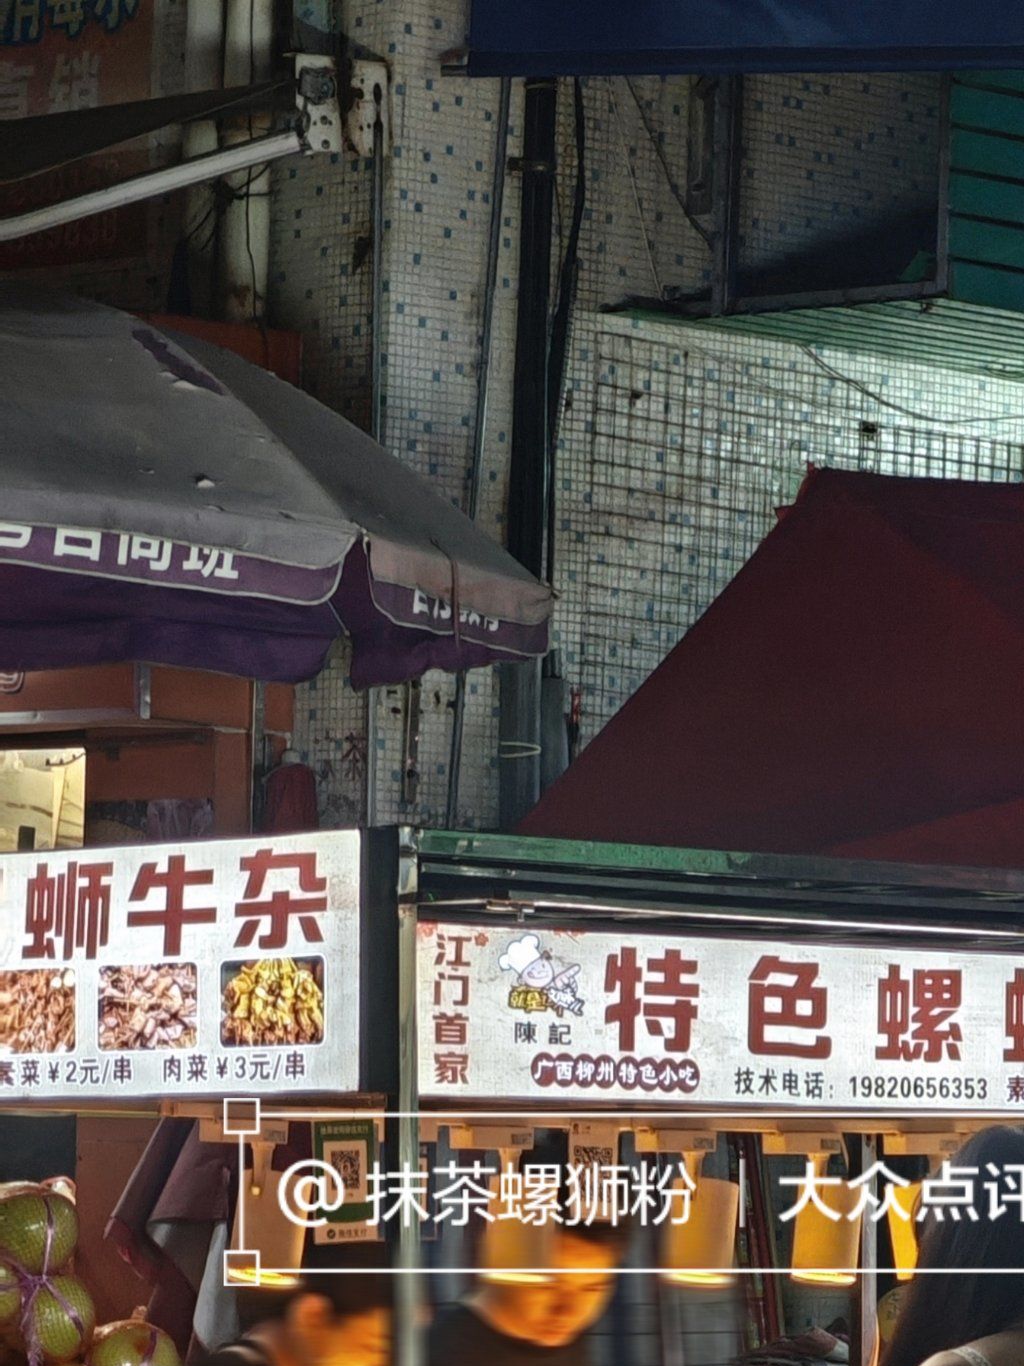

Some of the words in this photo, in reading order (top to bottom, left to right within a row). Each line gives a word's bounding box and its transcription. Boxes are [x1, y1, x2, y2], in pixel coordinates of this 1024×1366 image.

[432, 932, 472, 1085] 江门首家
[514, 1020, 572, 1046] 陳記
[849, 1075, 988, 1100] 19820656353
